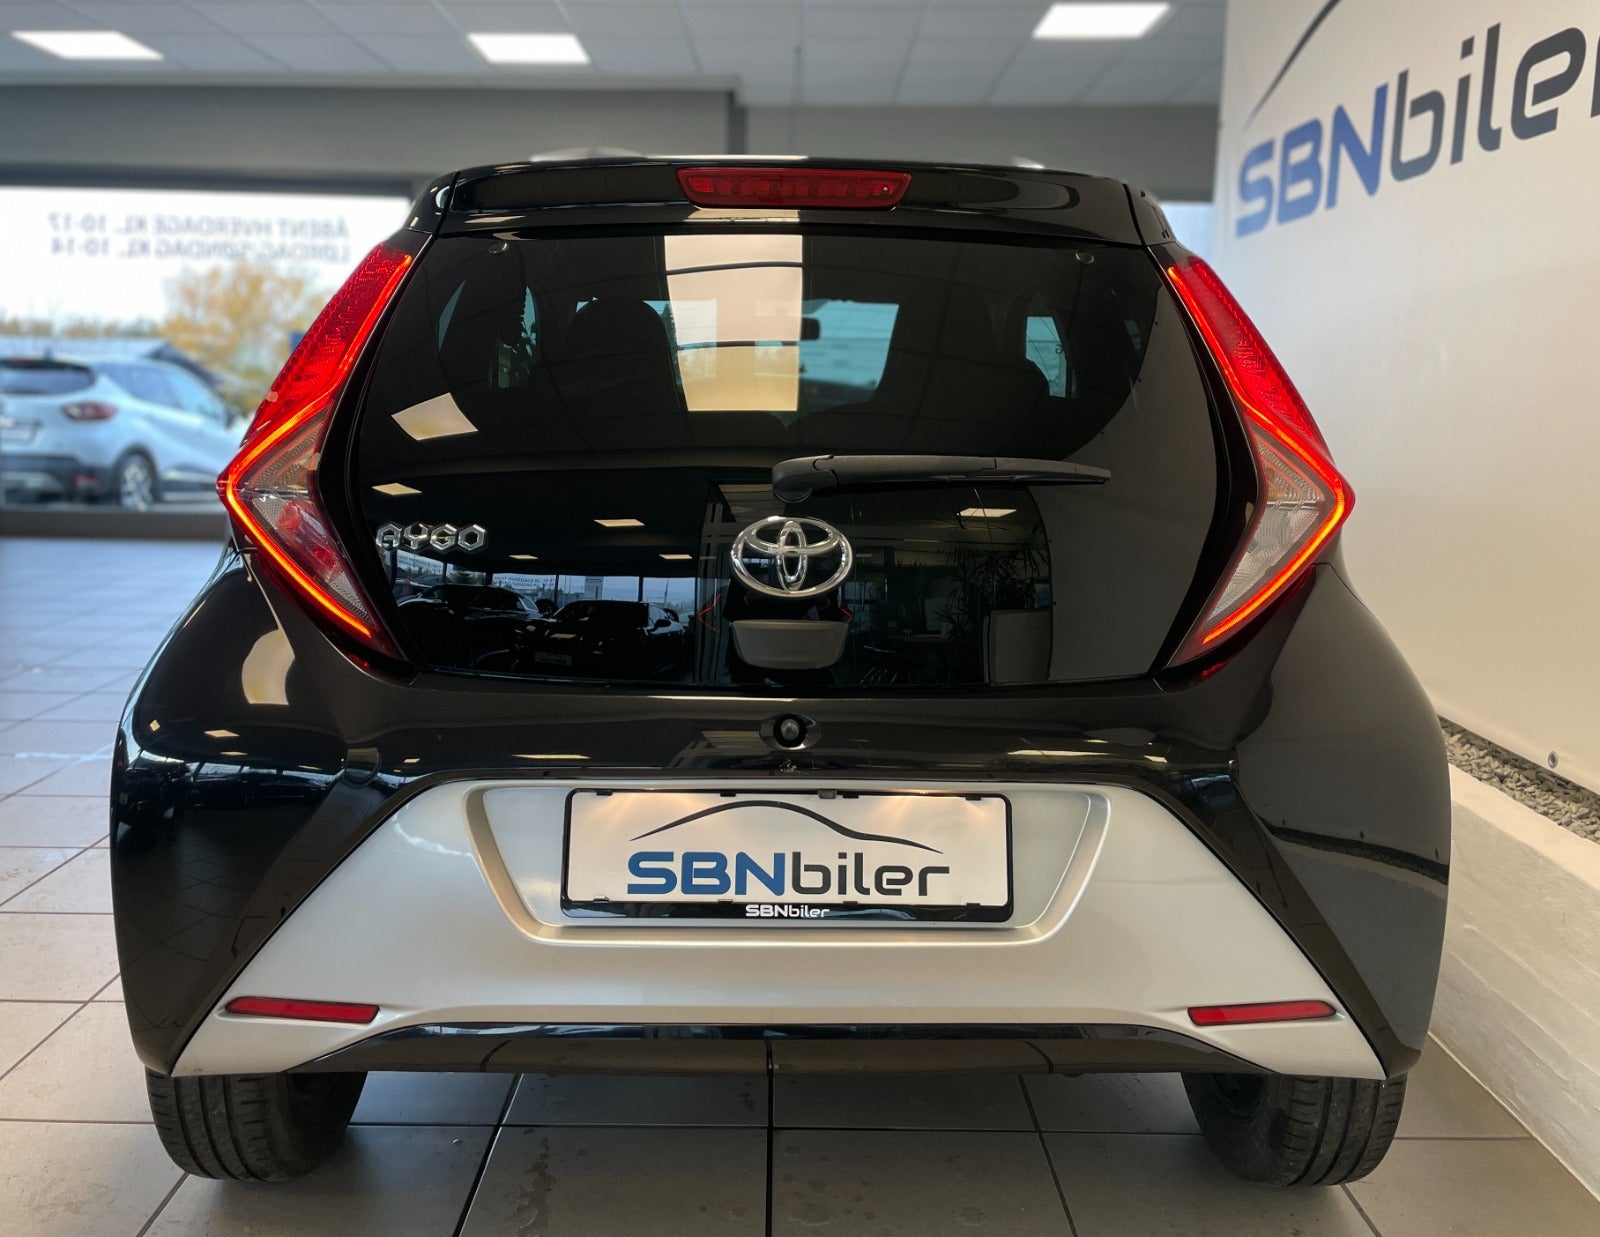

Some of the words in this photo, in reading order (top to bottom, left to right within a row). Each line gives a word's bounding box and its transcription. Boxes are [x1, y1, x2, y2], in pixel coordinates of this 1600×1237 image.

[375, 523, 486, 551] AYGO
[627, 851, 950, 897] SBNbiler
[745, 904, 830, 919] SBNbiler
